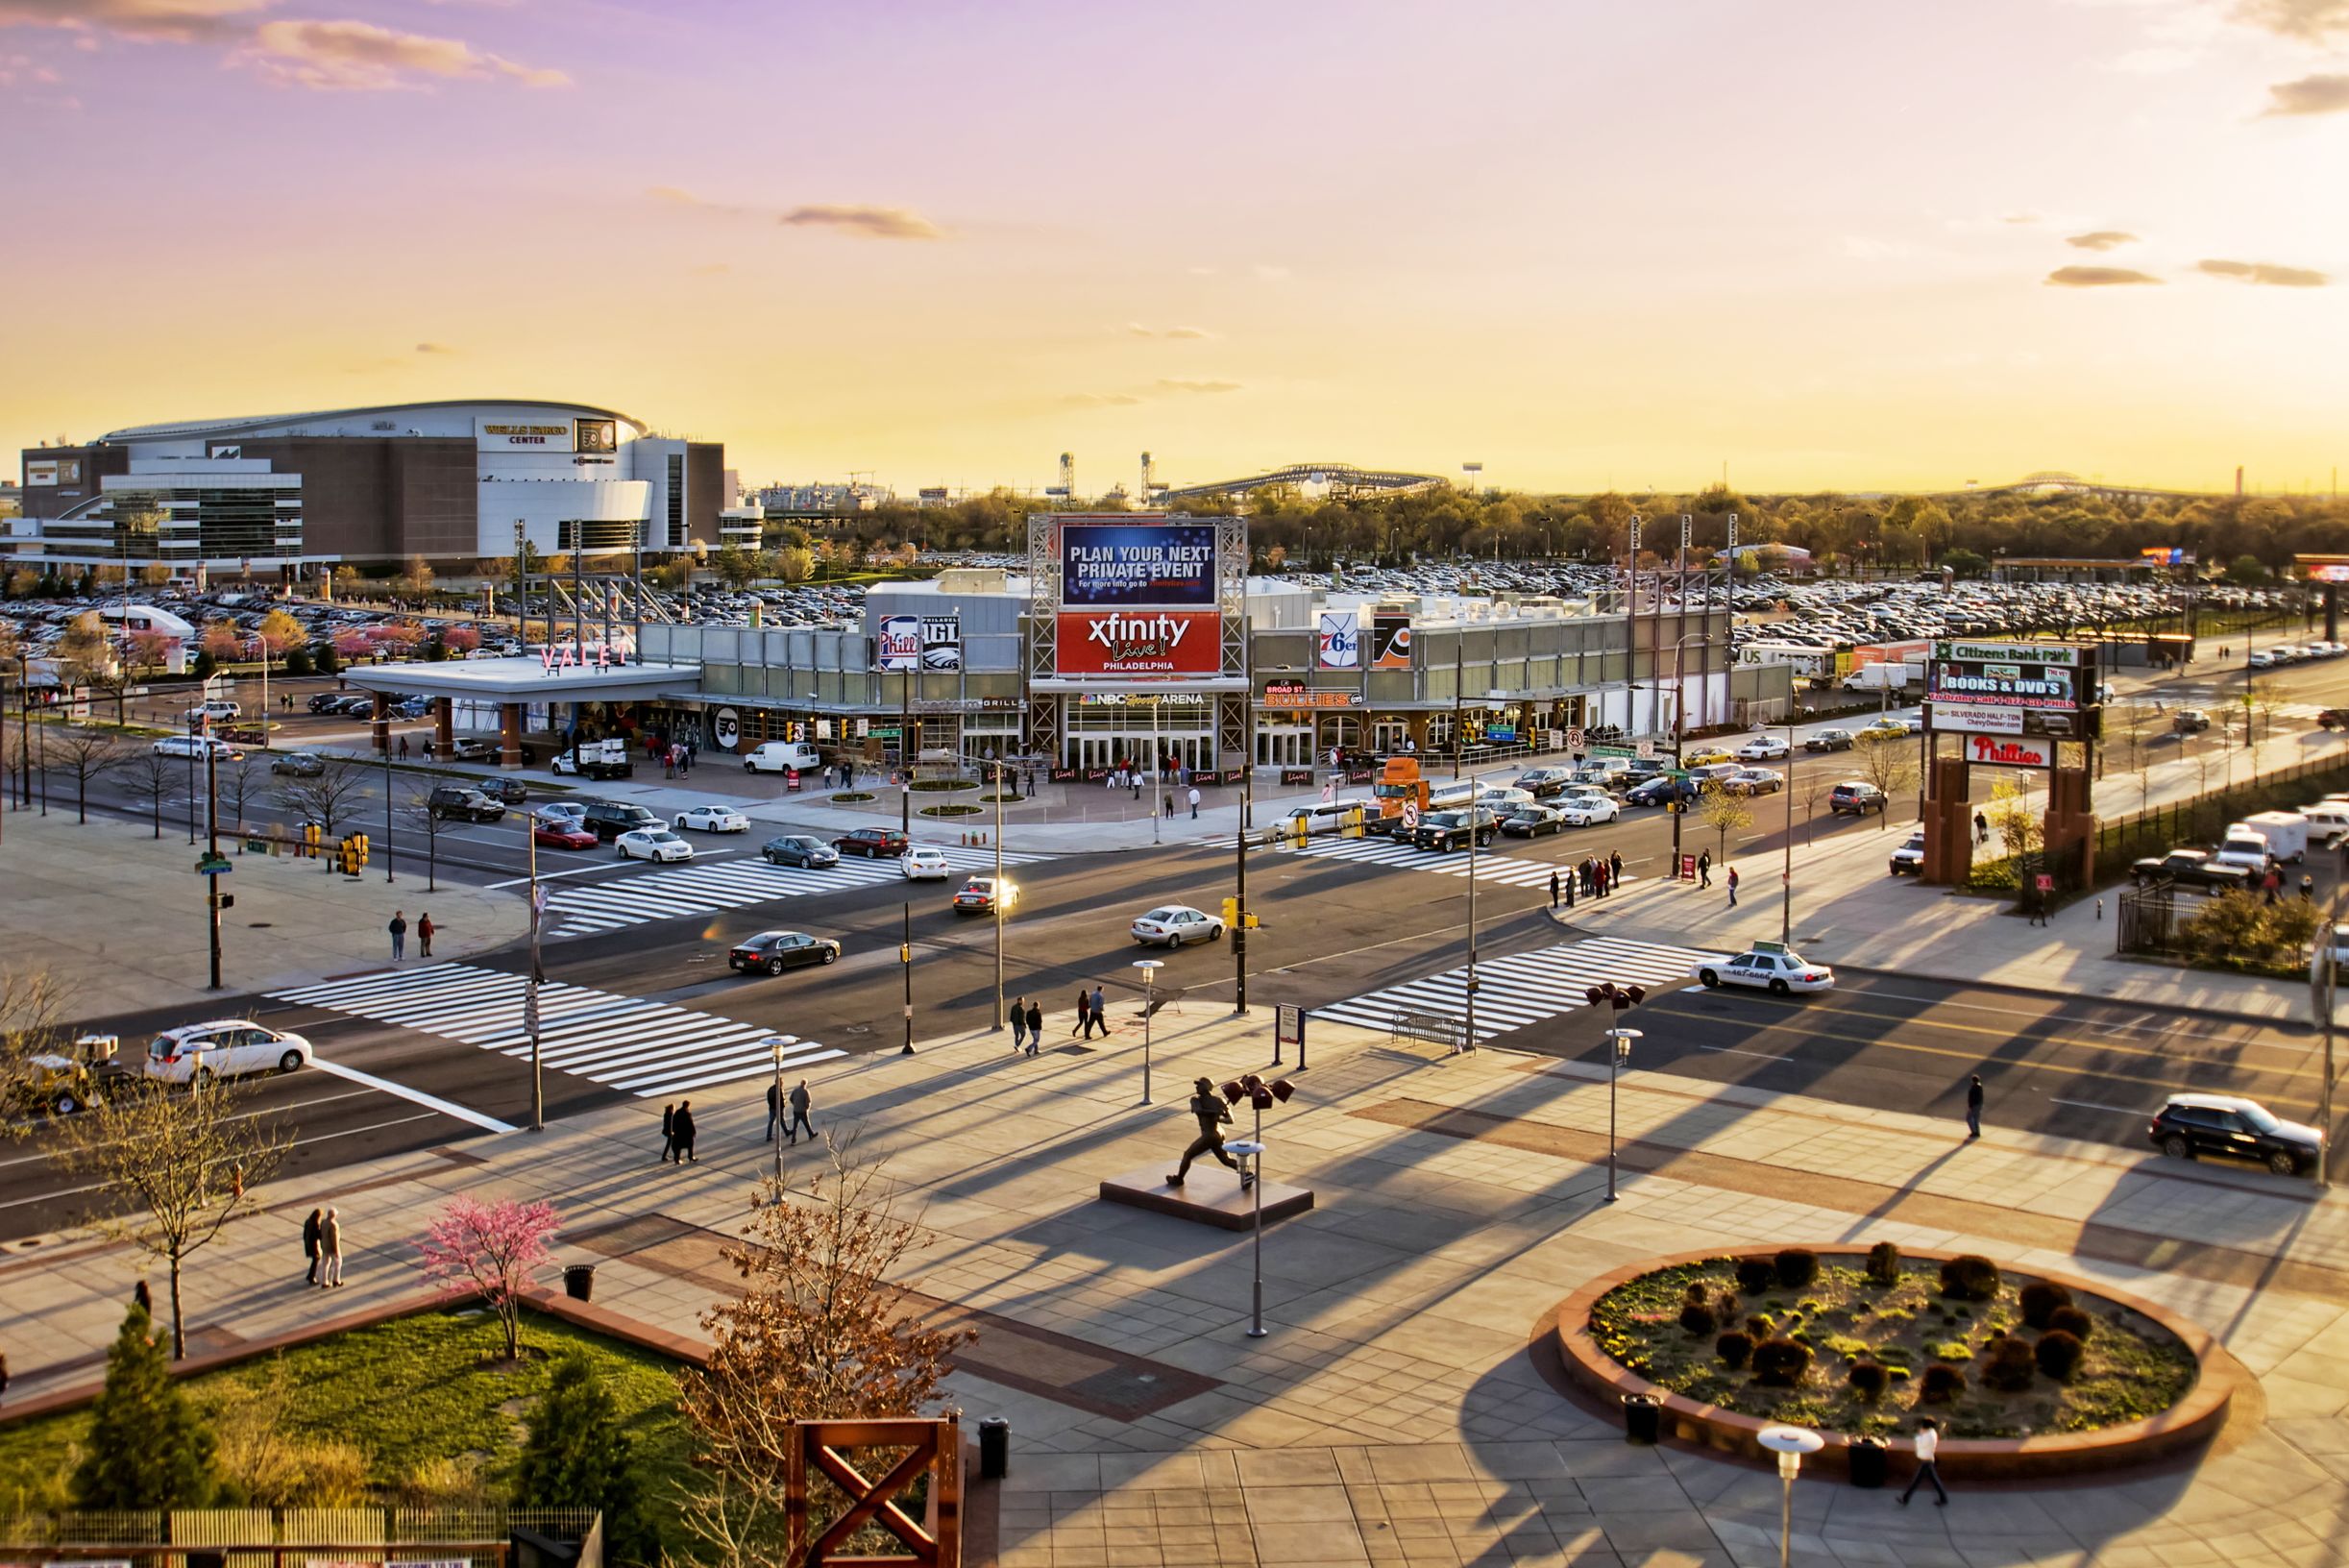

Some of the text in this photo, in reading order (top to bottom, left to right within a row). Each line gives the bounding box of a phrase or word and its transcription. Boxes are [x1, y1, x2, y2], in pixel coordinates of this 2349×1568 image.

[484, 425, 569, 435] WELLS FARGO
[1070, 547, 1211, 562] PLAN YOUR NEXT
[1078, 563, 1204, 577] PRIVATE EVENT
[1088, 613, 1190, 648] xfinity
[1113, 636, 1166, 662] Live!
[1956, 646, 2071, 663] Citizens Bank Park
[541, 644, 627, 669] VALET
[1947, 676, 2061, 695] BOOKS & DVD'S
[1096, 694, 1126, 705] NBC
[1161, 694, 1204, 704] ARENA
[1264, 693, 1349, 707] BULLIES
[1929, 692, 1942, 701] To
[1975, 695, 1995, 704] Call
[1950, 710, 2020, 721] SILVERADO HALF-TON
[1973, 735, 2043, 765] Phillies
[1055, 770, 1075, 779] Live!
[1287, 772, 1308, 781] Live!
